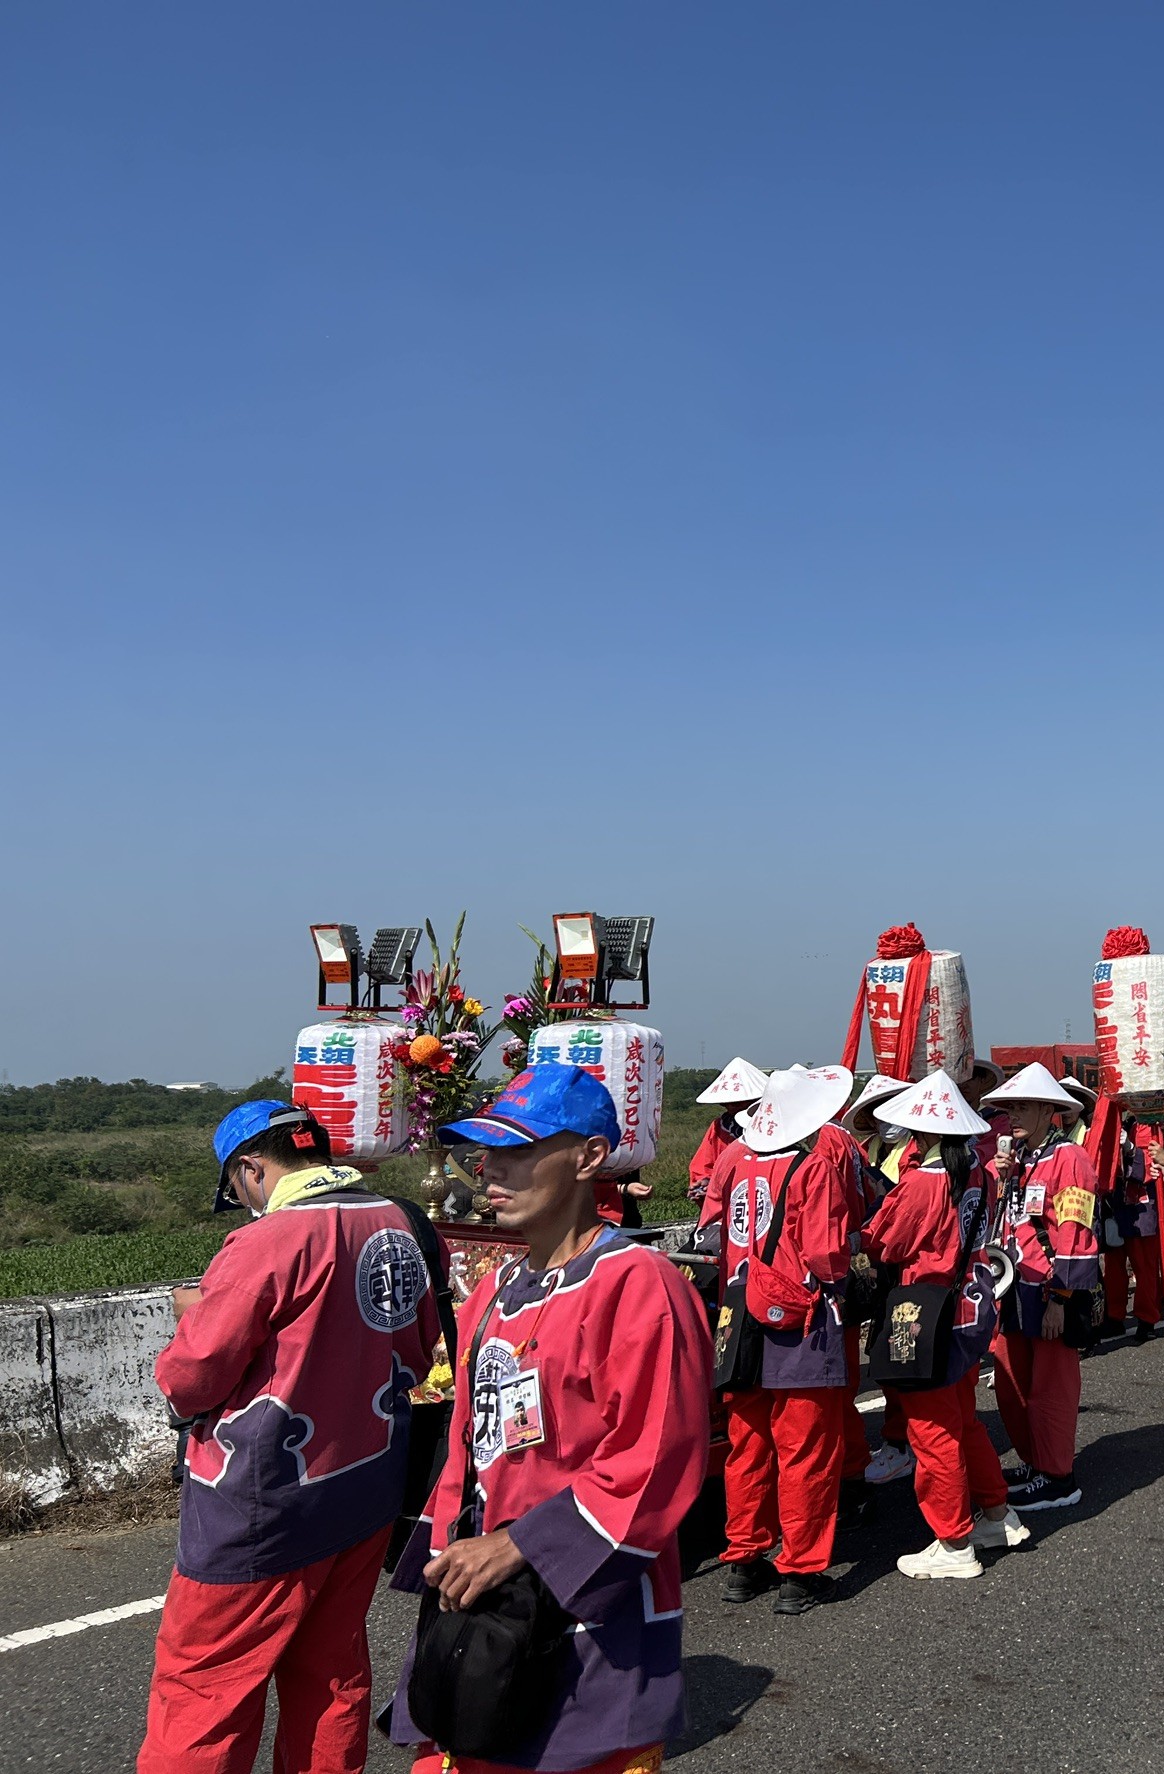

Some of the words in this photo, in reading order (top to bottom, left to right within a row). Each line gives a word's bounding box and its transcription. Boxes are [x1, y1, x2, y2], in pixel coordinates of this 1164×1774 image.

[922, 1090, 951, 1103] 北港
[908, 1103, 958, 1121] 朝天宮
